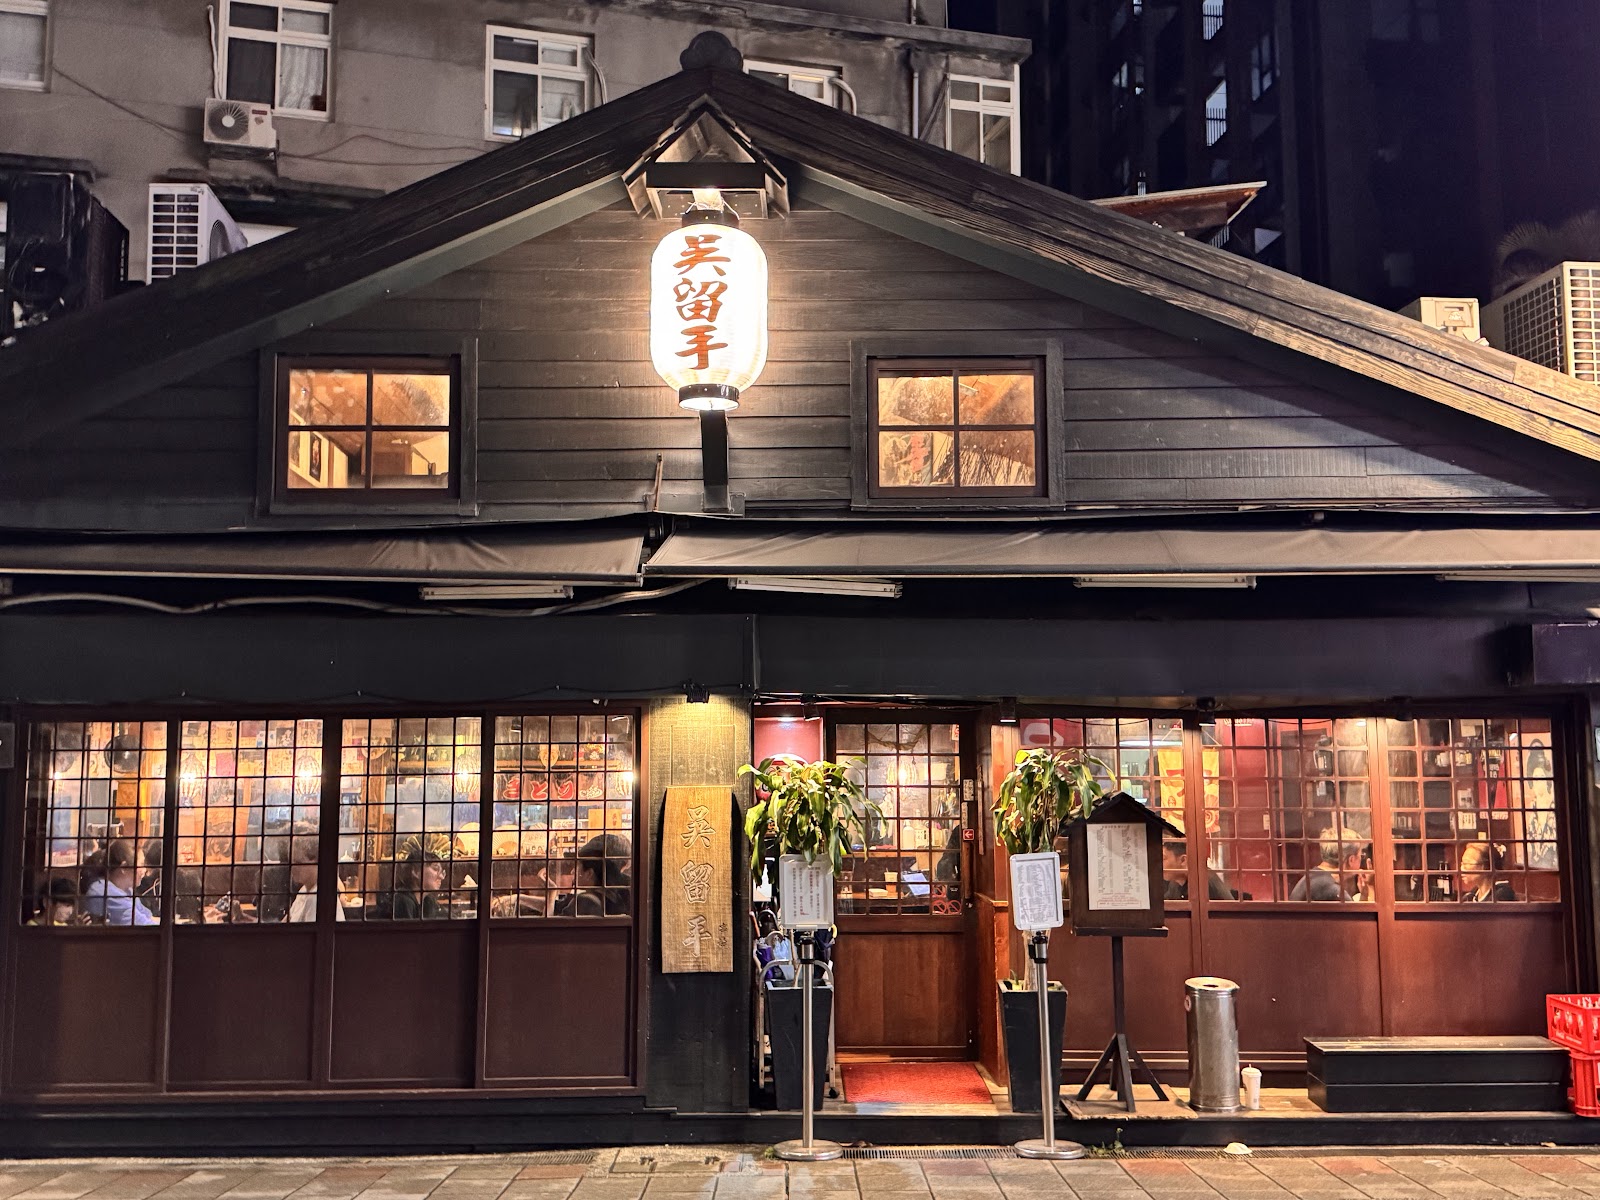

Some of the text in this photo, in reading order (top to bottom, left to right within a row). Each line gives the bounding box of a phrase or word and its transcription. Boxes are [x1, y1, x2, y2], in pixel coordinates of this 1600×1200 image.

[673, 234, 731, 370] 吳留手
[680, 805, 716, 958] 吳留手
